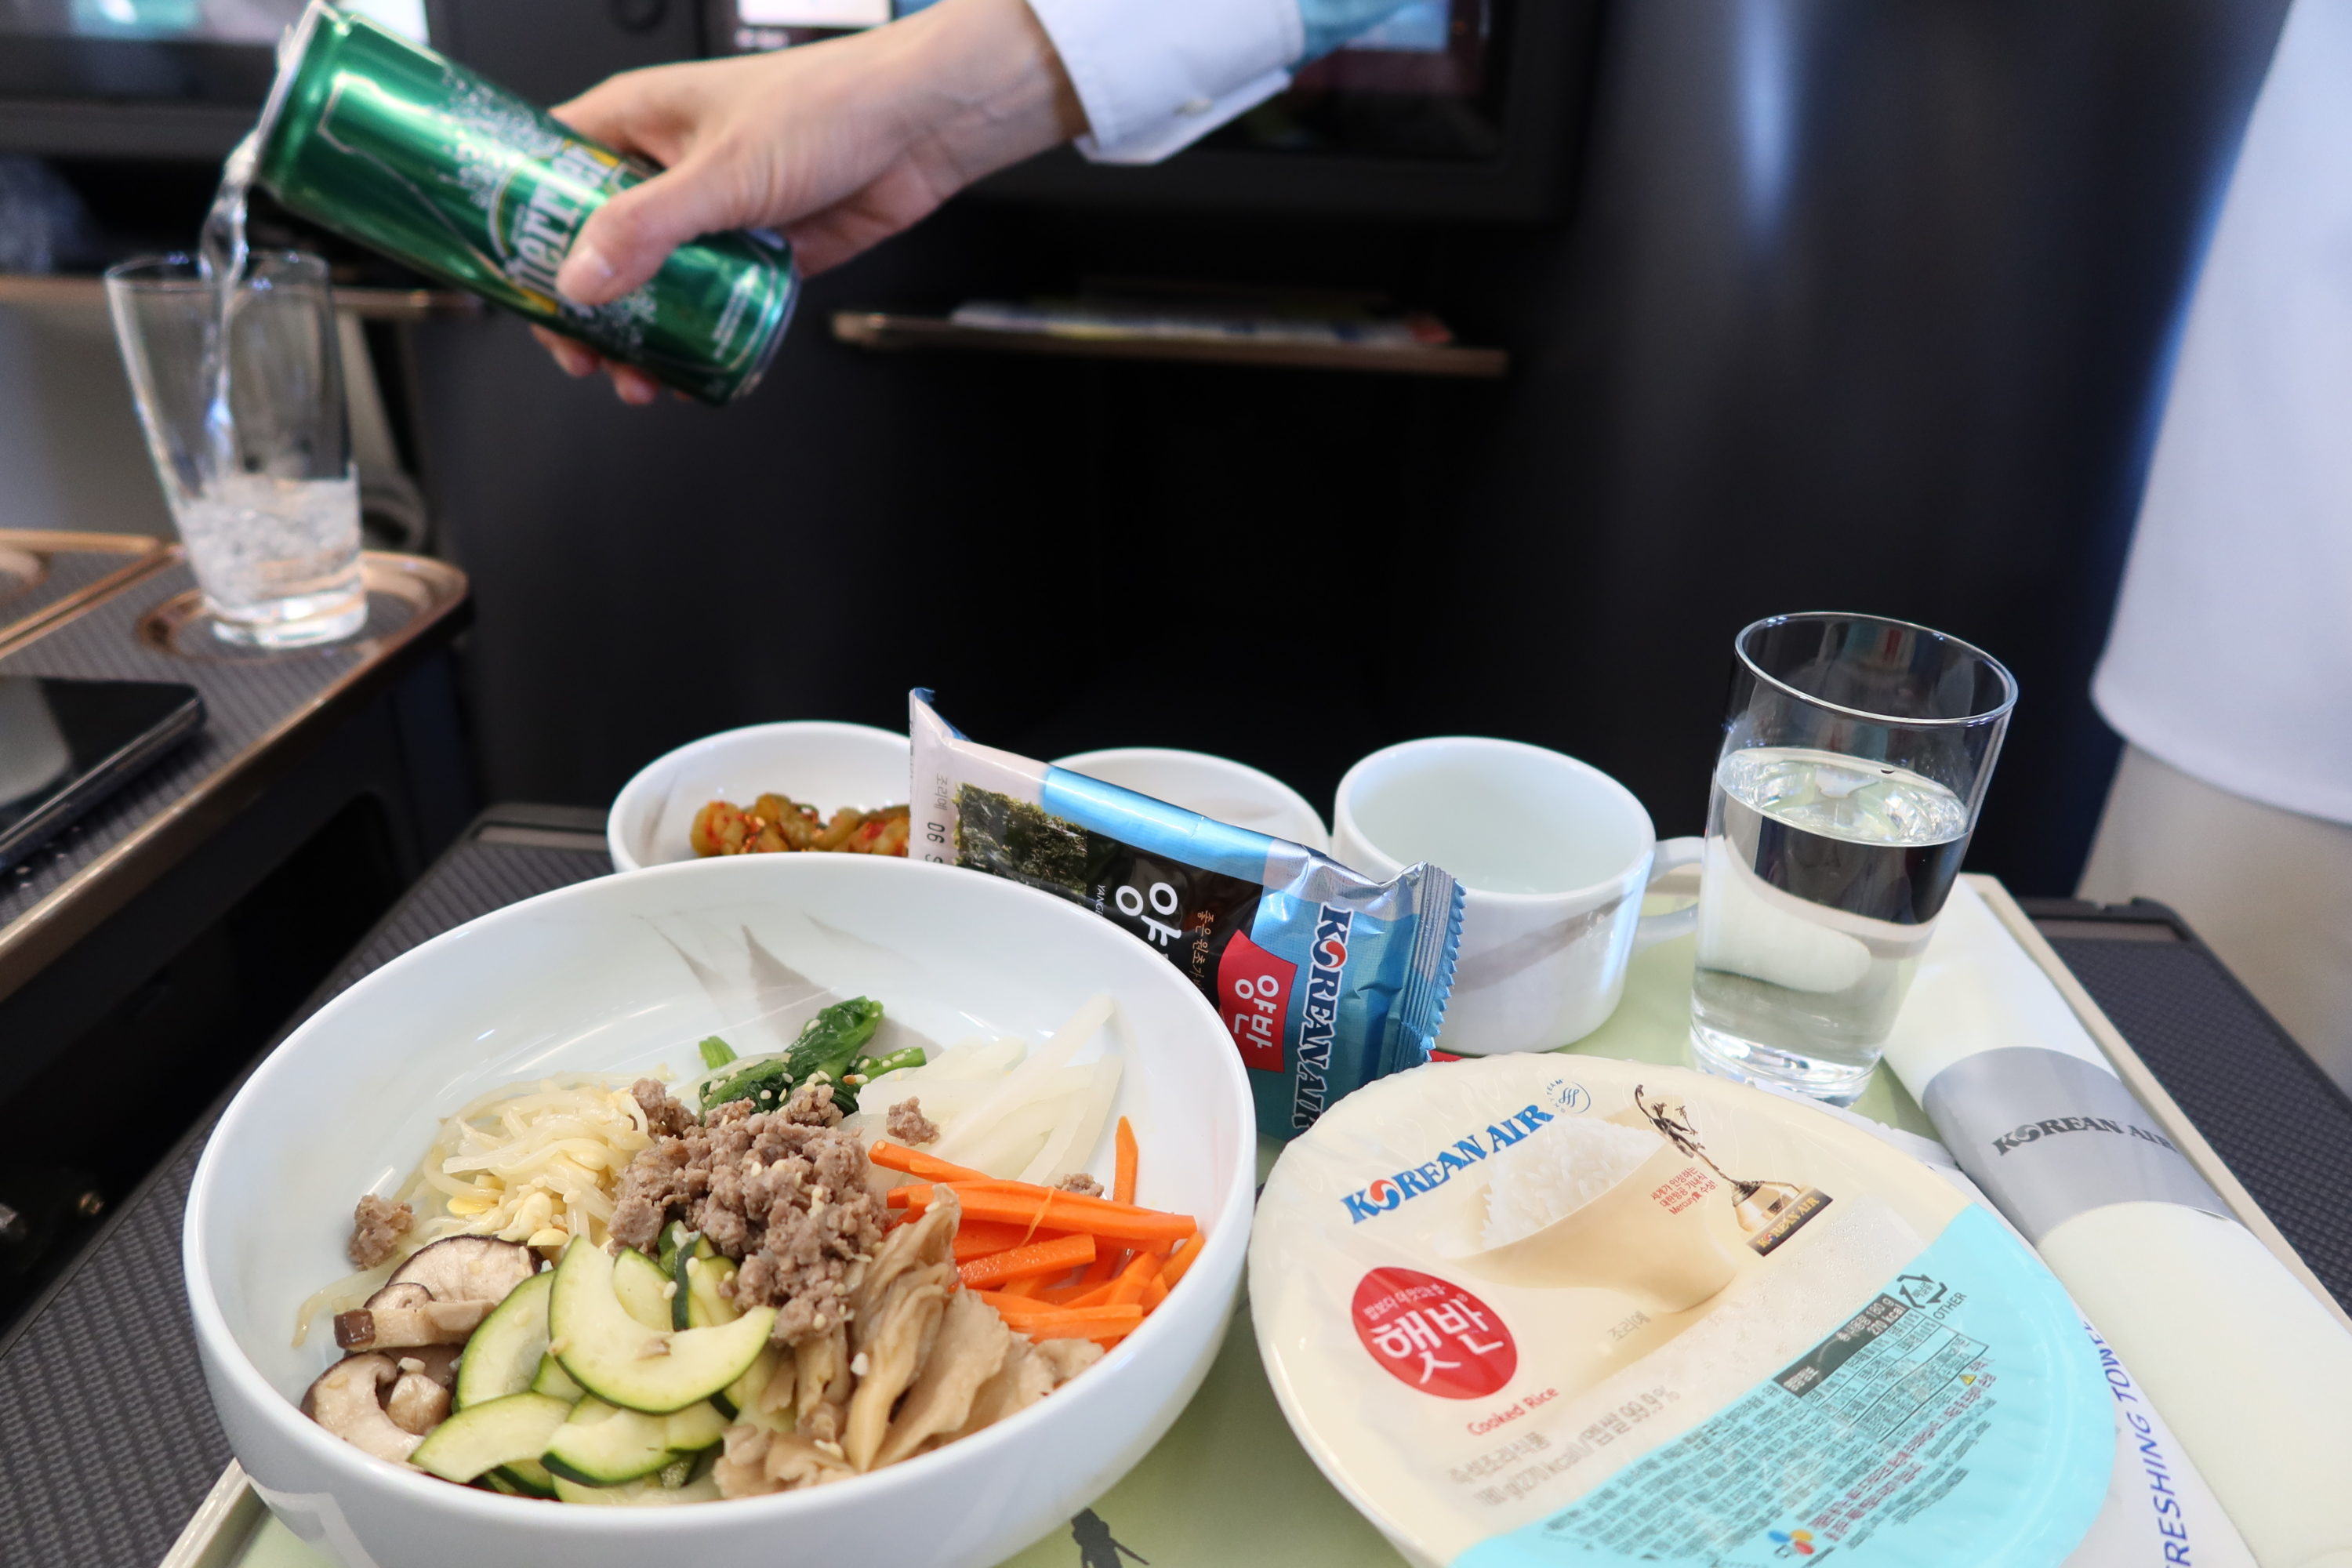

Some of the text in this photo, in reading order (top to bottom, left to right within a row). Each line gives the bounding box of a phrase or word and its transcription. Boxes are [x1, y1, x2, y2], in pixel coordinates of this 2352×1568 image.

[935, 773, 948, 811] 조리예
[1297, 902, 1353, 1070] KOREAN
[1235, 975, 1279, 1049] 양반
[1991, 1116, 2125, 1156] KOREAN
[1340, 1104, 1555, 1225] KOREAN AIR
[1669, 1166, 1698, 1188] 인정하는
[1659, 1172, 1708, 1207] 대한항공 기내식
[1756, 1196, 1820, 1248] KOREAN AIR
[1885, 1304, 1908, 1325] kcal
[1933, 1291, 1968, 1322] OTHER
[1370, 1298, 1505, 1385] 햇반
[1467, 1387, 1559, 1436] Cooked Rice
[2125, 1410, 2192, 1568] RESHING
